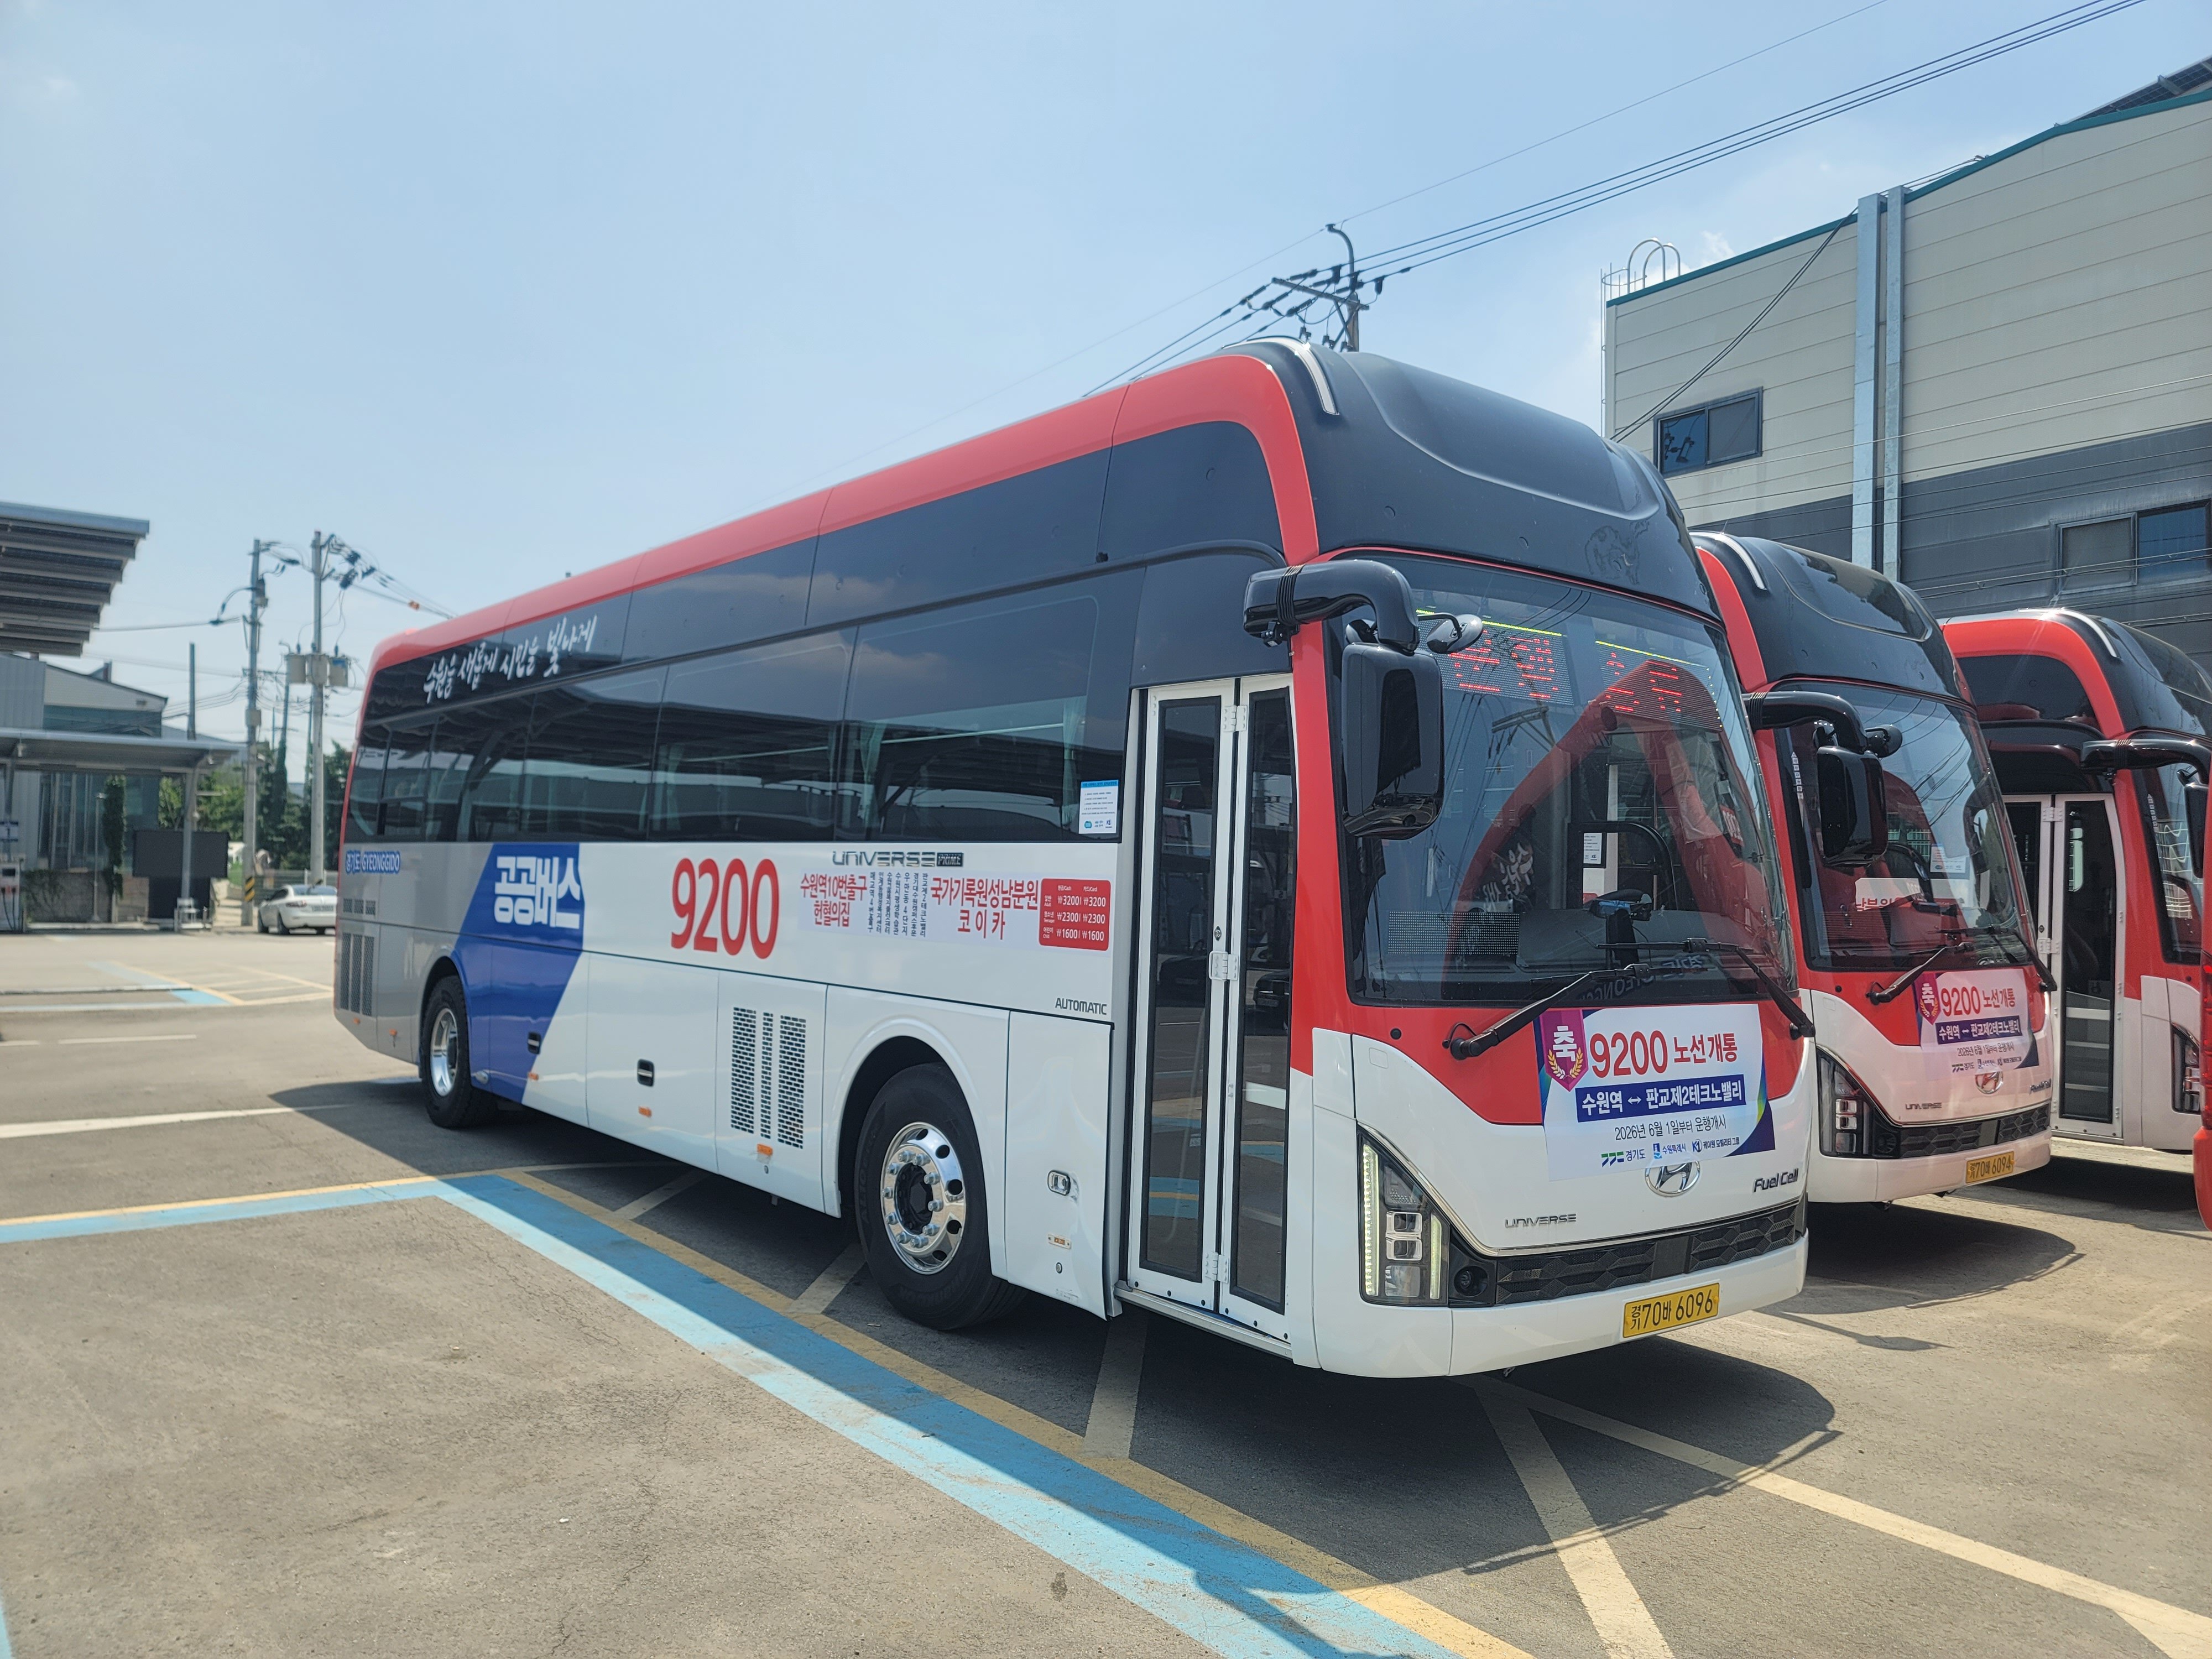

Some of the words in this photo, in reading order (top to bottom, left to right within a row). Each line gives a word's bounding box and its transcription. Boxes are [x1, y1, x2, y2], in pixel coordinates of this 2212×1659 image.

[423, 653, 457, 705] 수원을
[457, 641, 498, 691] 새롭게
[499, 635, 540, 681] 시민을
[542, 614, 598, 678] 빛나게
[346, 852, 361, 873] 경기도
[362, 852, 400, 872] GYEONGGIDO
[832, 851, 936, 867] UNIVERSE
[938, 853, 962, 865] PRIME
[494, 855, 581, 929] 공공버스
[800, 873, 868, 901] 수원역10번출구
[930, 876, 1039, 912] 국가기록원성남분원
[671, 858, 779, 959] 9200
[813, 900, 850, 927] 헌혈의집
[957, 909, 1005, 940] 코이카
[1055, 998, 1107, 1015] AUTOMATIC
[1921, 983, 1936, 1007] 축
[1940, 986, 1980, 1016] 9200
[1982, 988, 2016, 1008] 노선개통
[1553, 1025, 1577, 1061] 축
[1938, 1024, 1960, 1041] 수원역
[1590, 1030, 1668, 1078] 9200
[1673, 1032, 1738, 1063] 노선개통
[1582, 1091, 1623, 1116] 수원역
[1646, 1080, 1742, 1109] 판교제2테크노밸리
[1614, 1123, 1646, 1140] 2026년
[1648, 1121, 1663, 1137] 6월
[1666, 1120, 1693, 1135] 1일부터
[1695, 1114, 1726, 1132] 운행개시
[1625, 1149, 1646, 1162] 경기도
[1992, 1155, 2011, 1175] 6094
[1752, 1176, 1779, 1193] Fuel
[1780, 1167, 1799, 1186] Cell
[1504, 1214, 1576, 1229] UNIVERSE
[1676, 1289, 1713, 1321] 6096
